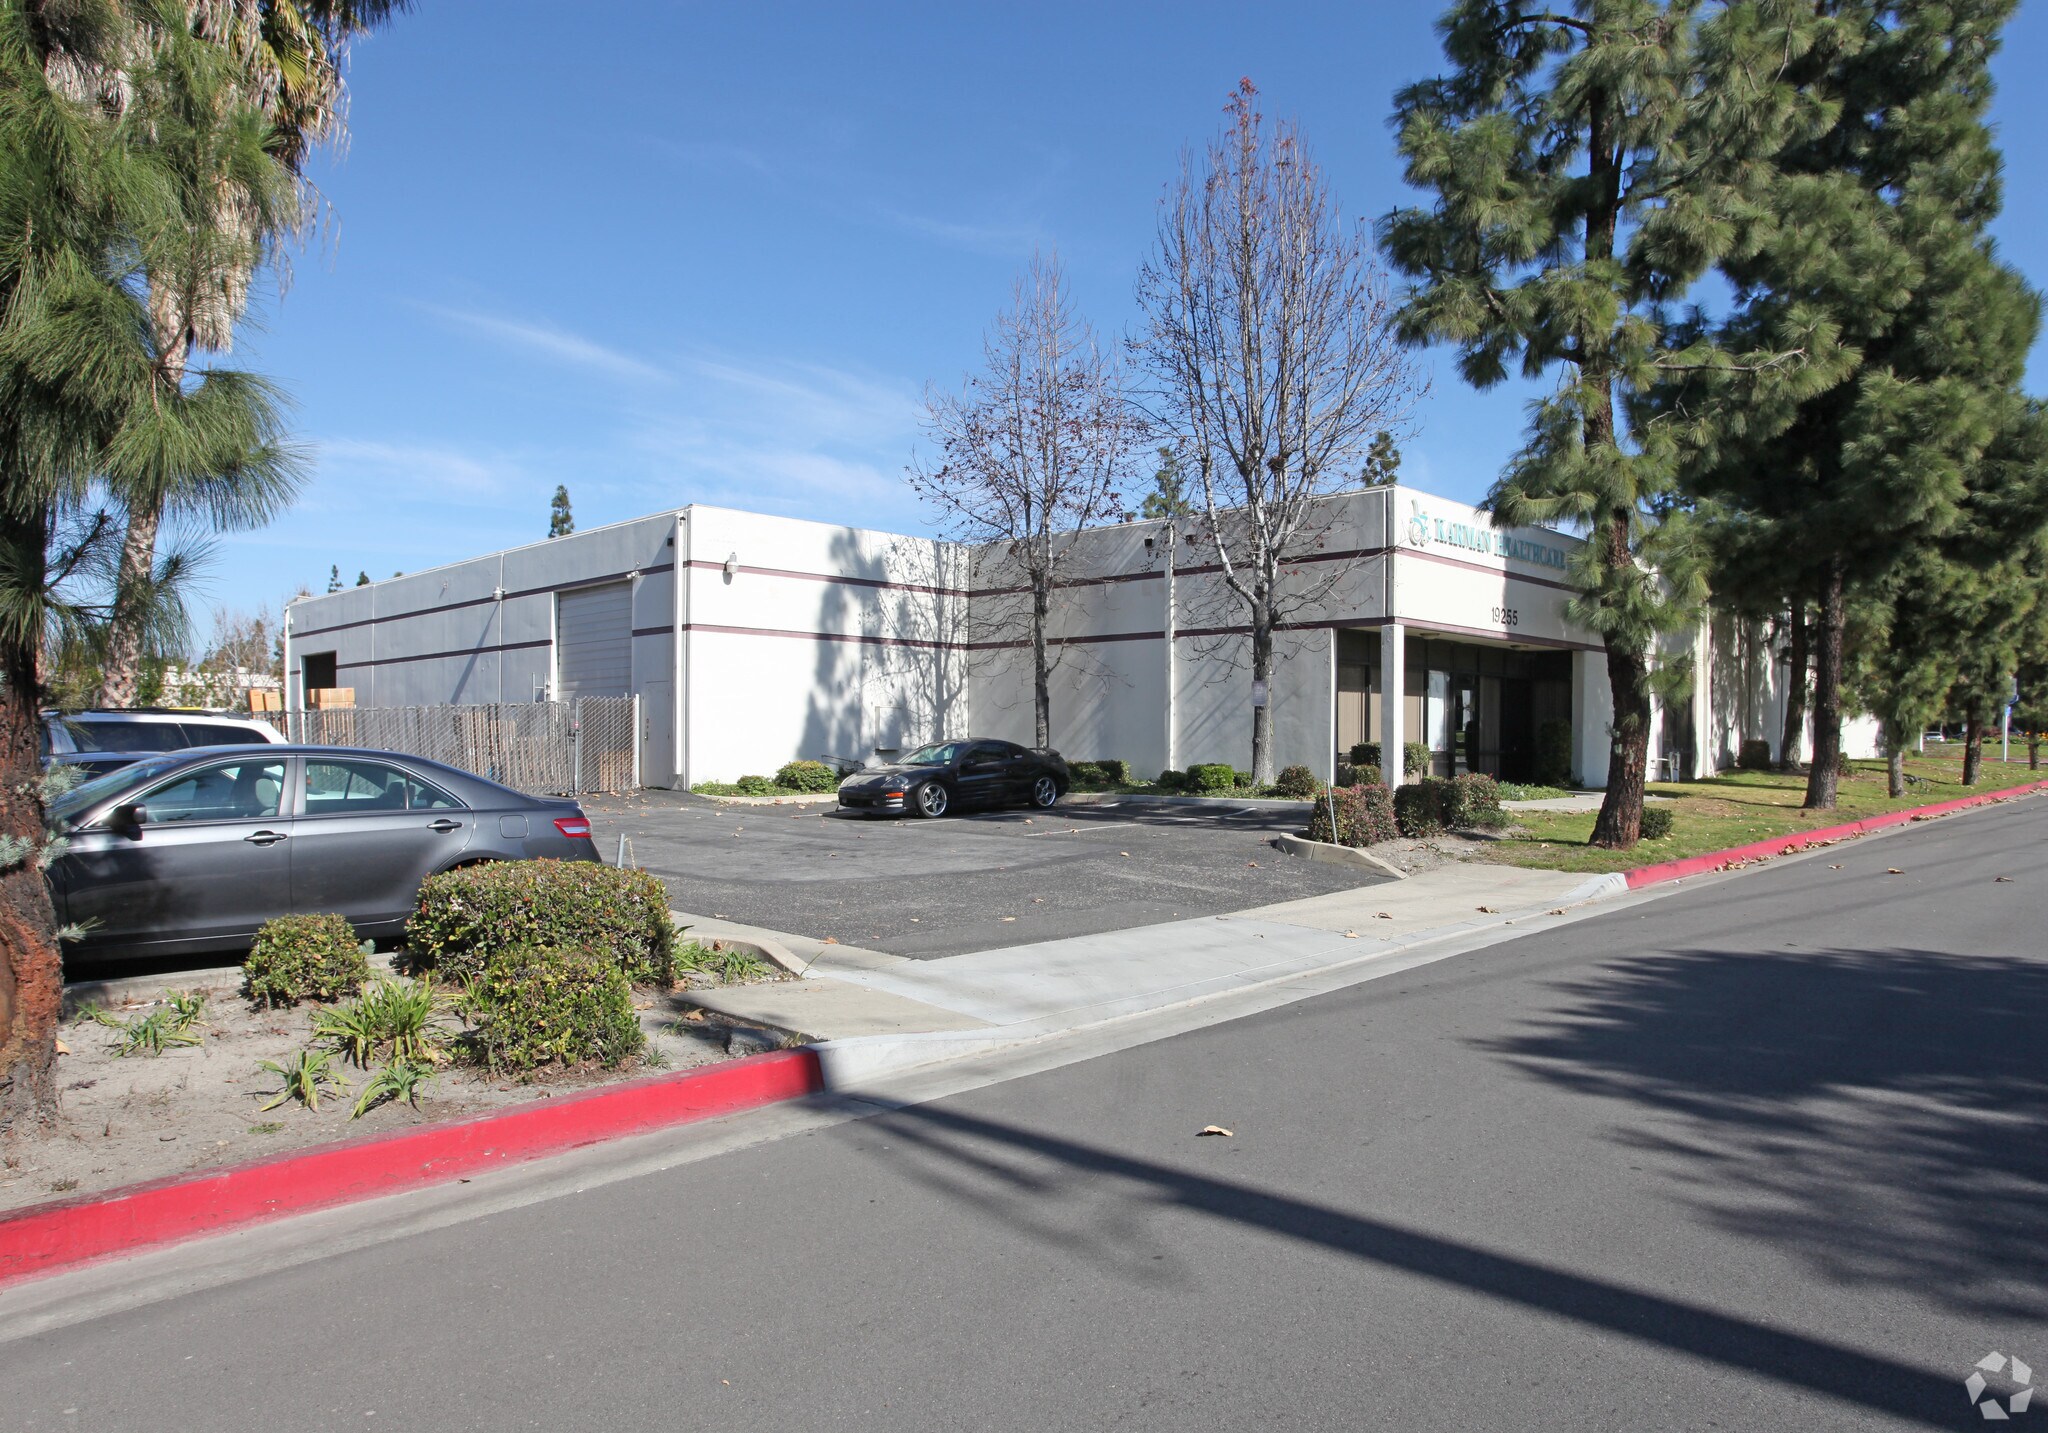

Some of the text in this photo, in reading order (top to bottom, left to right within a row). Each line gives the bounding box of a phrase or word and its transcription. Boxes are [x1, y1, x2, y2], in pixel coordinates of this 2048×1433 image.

[1434, 518, 1566, 570] KARMAN HEALTHCARE
[1491, 607, 1518, 626] 19255
